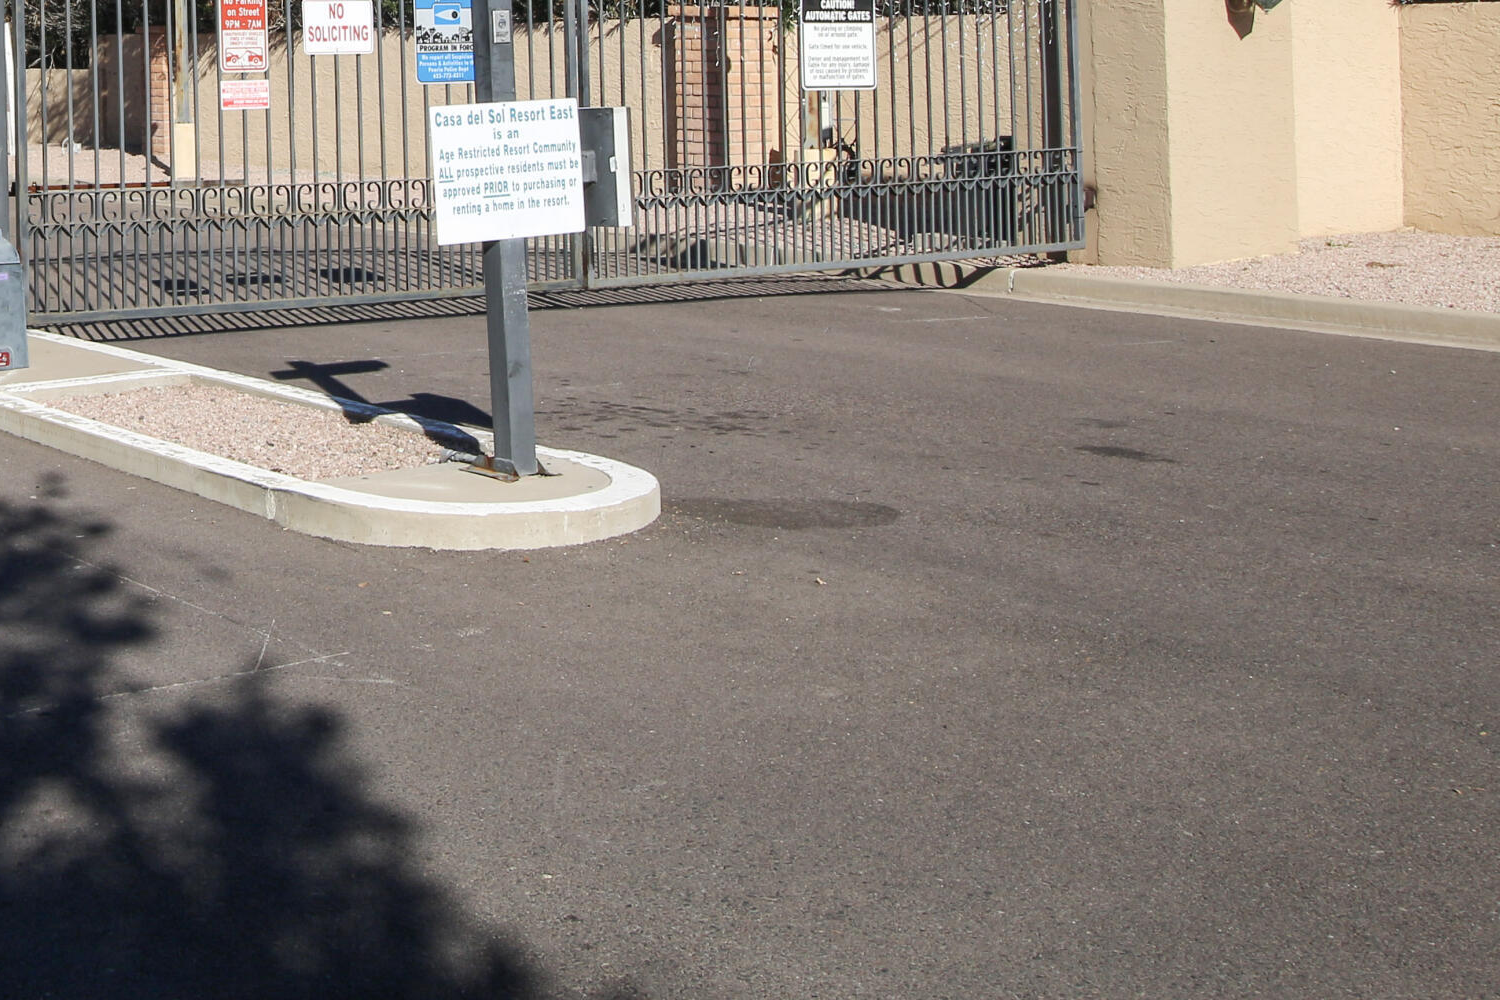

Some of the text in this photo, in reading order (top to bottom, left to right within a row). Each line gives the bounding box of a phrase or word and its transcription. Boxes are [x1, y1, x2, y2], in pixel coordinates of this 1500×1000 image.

[238, 7, 260, 17] Street
[329, 3, 344, 19] NO
[820, 0, 855, 9] CAUTION!
[805, 10, 871, 21] AUTOMATIC GATES
[224, 19, 240, 28] 9PM
[247, 19, 262, 29] 7AM
[308, 25, 369, 42] SOLICITING
[420, 44, 449, 52] PROGRAM
[459, 44, 474, 52] FORC
[435, 105, 574, 127] Casa del Sol Resort East
[493, 128, 519, 140] is an
[439, 139, 576, 163] Age Restricted Resort Community
[439, 157, 579, 180] ALL prospective residents must be
[443, 177, 577, 199] approved PRIOR to purchasing or
[452, 195, 570, 215] renting a home in the resort.
